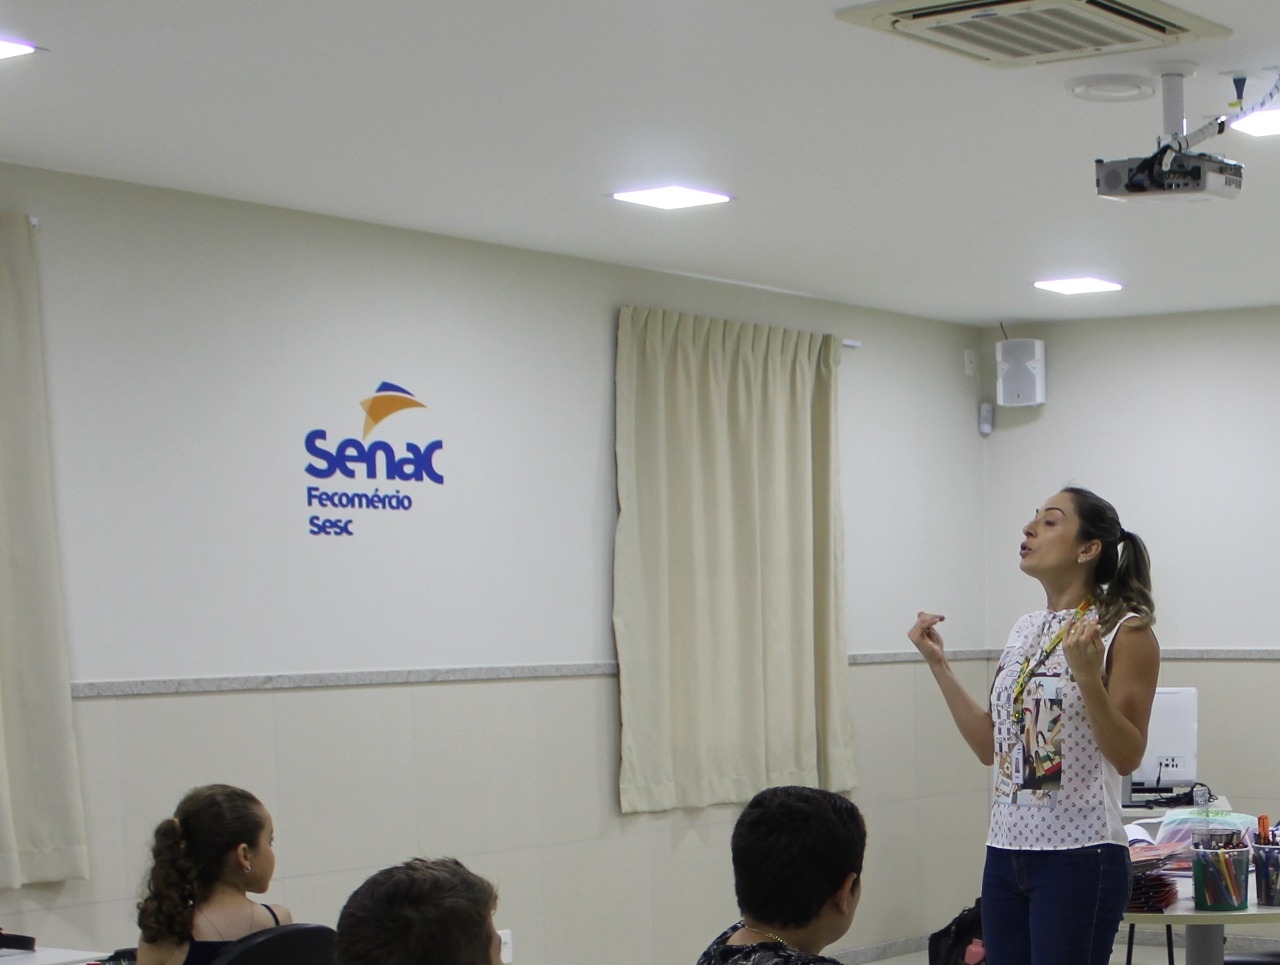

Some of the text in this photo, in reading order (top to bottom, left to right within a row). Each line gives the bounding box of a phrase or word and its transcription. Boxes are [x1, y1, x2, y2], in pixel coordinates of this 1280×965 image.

[304, 428, 444, 485] Senac
[306, 486, 413, 511] Fecomércio
[308, 515, 354, 536] Sesc
